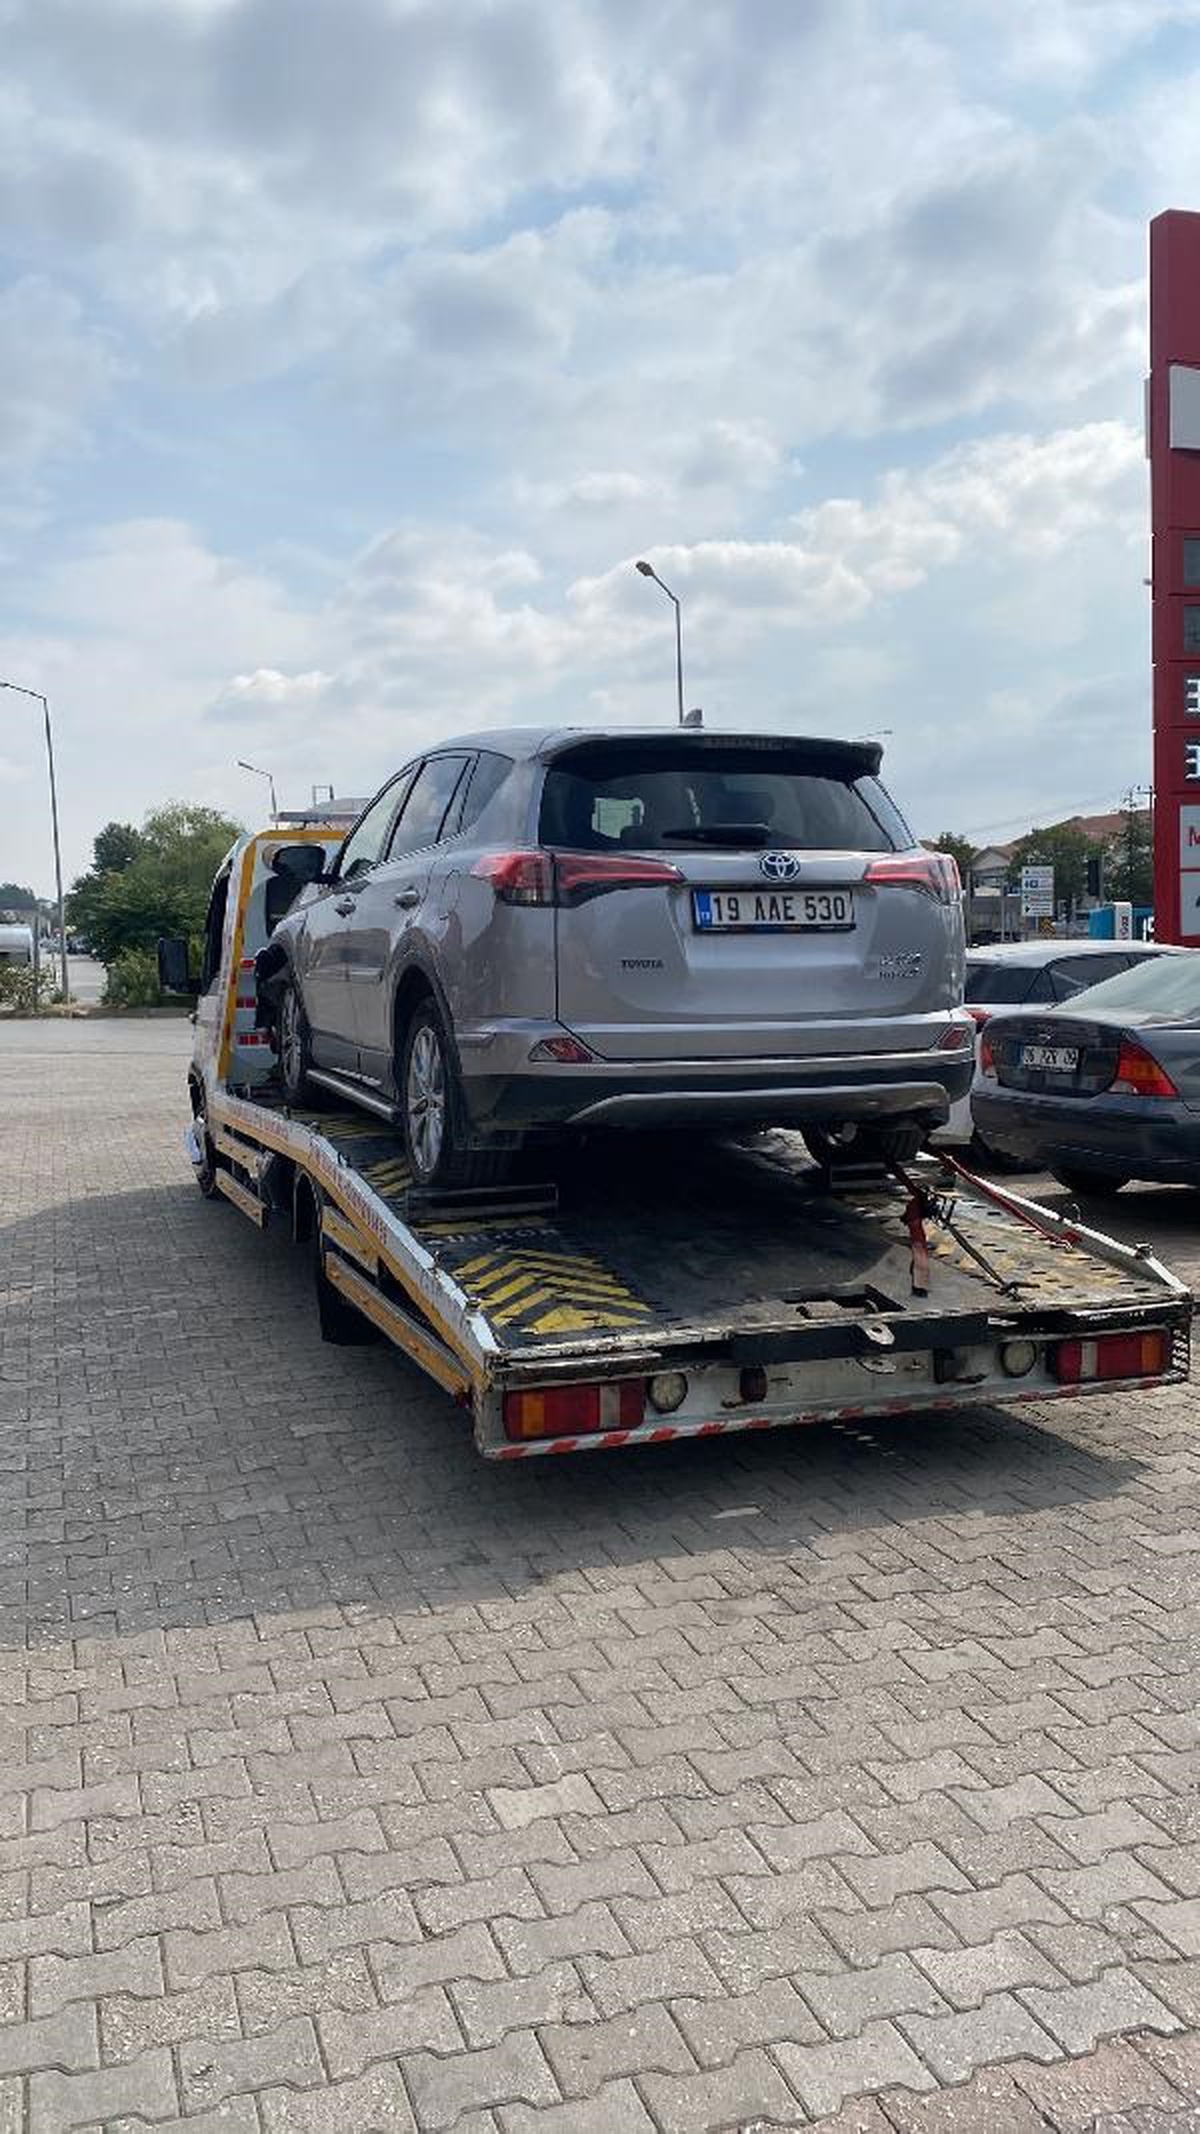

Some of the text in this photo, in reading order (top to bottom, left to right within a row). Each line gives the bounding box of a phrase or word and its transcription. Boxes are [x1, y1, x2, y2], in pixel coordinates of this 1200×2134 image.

[713, 895, 846, 921] 19 AAE 530
[621, 959, 664, 969] TOYOTA
